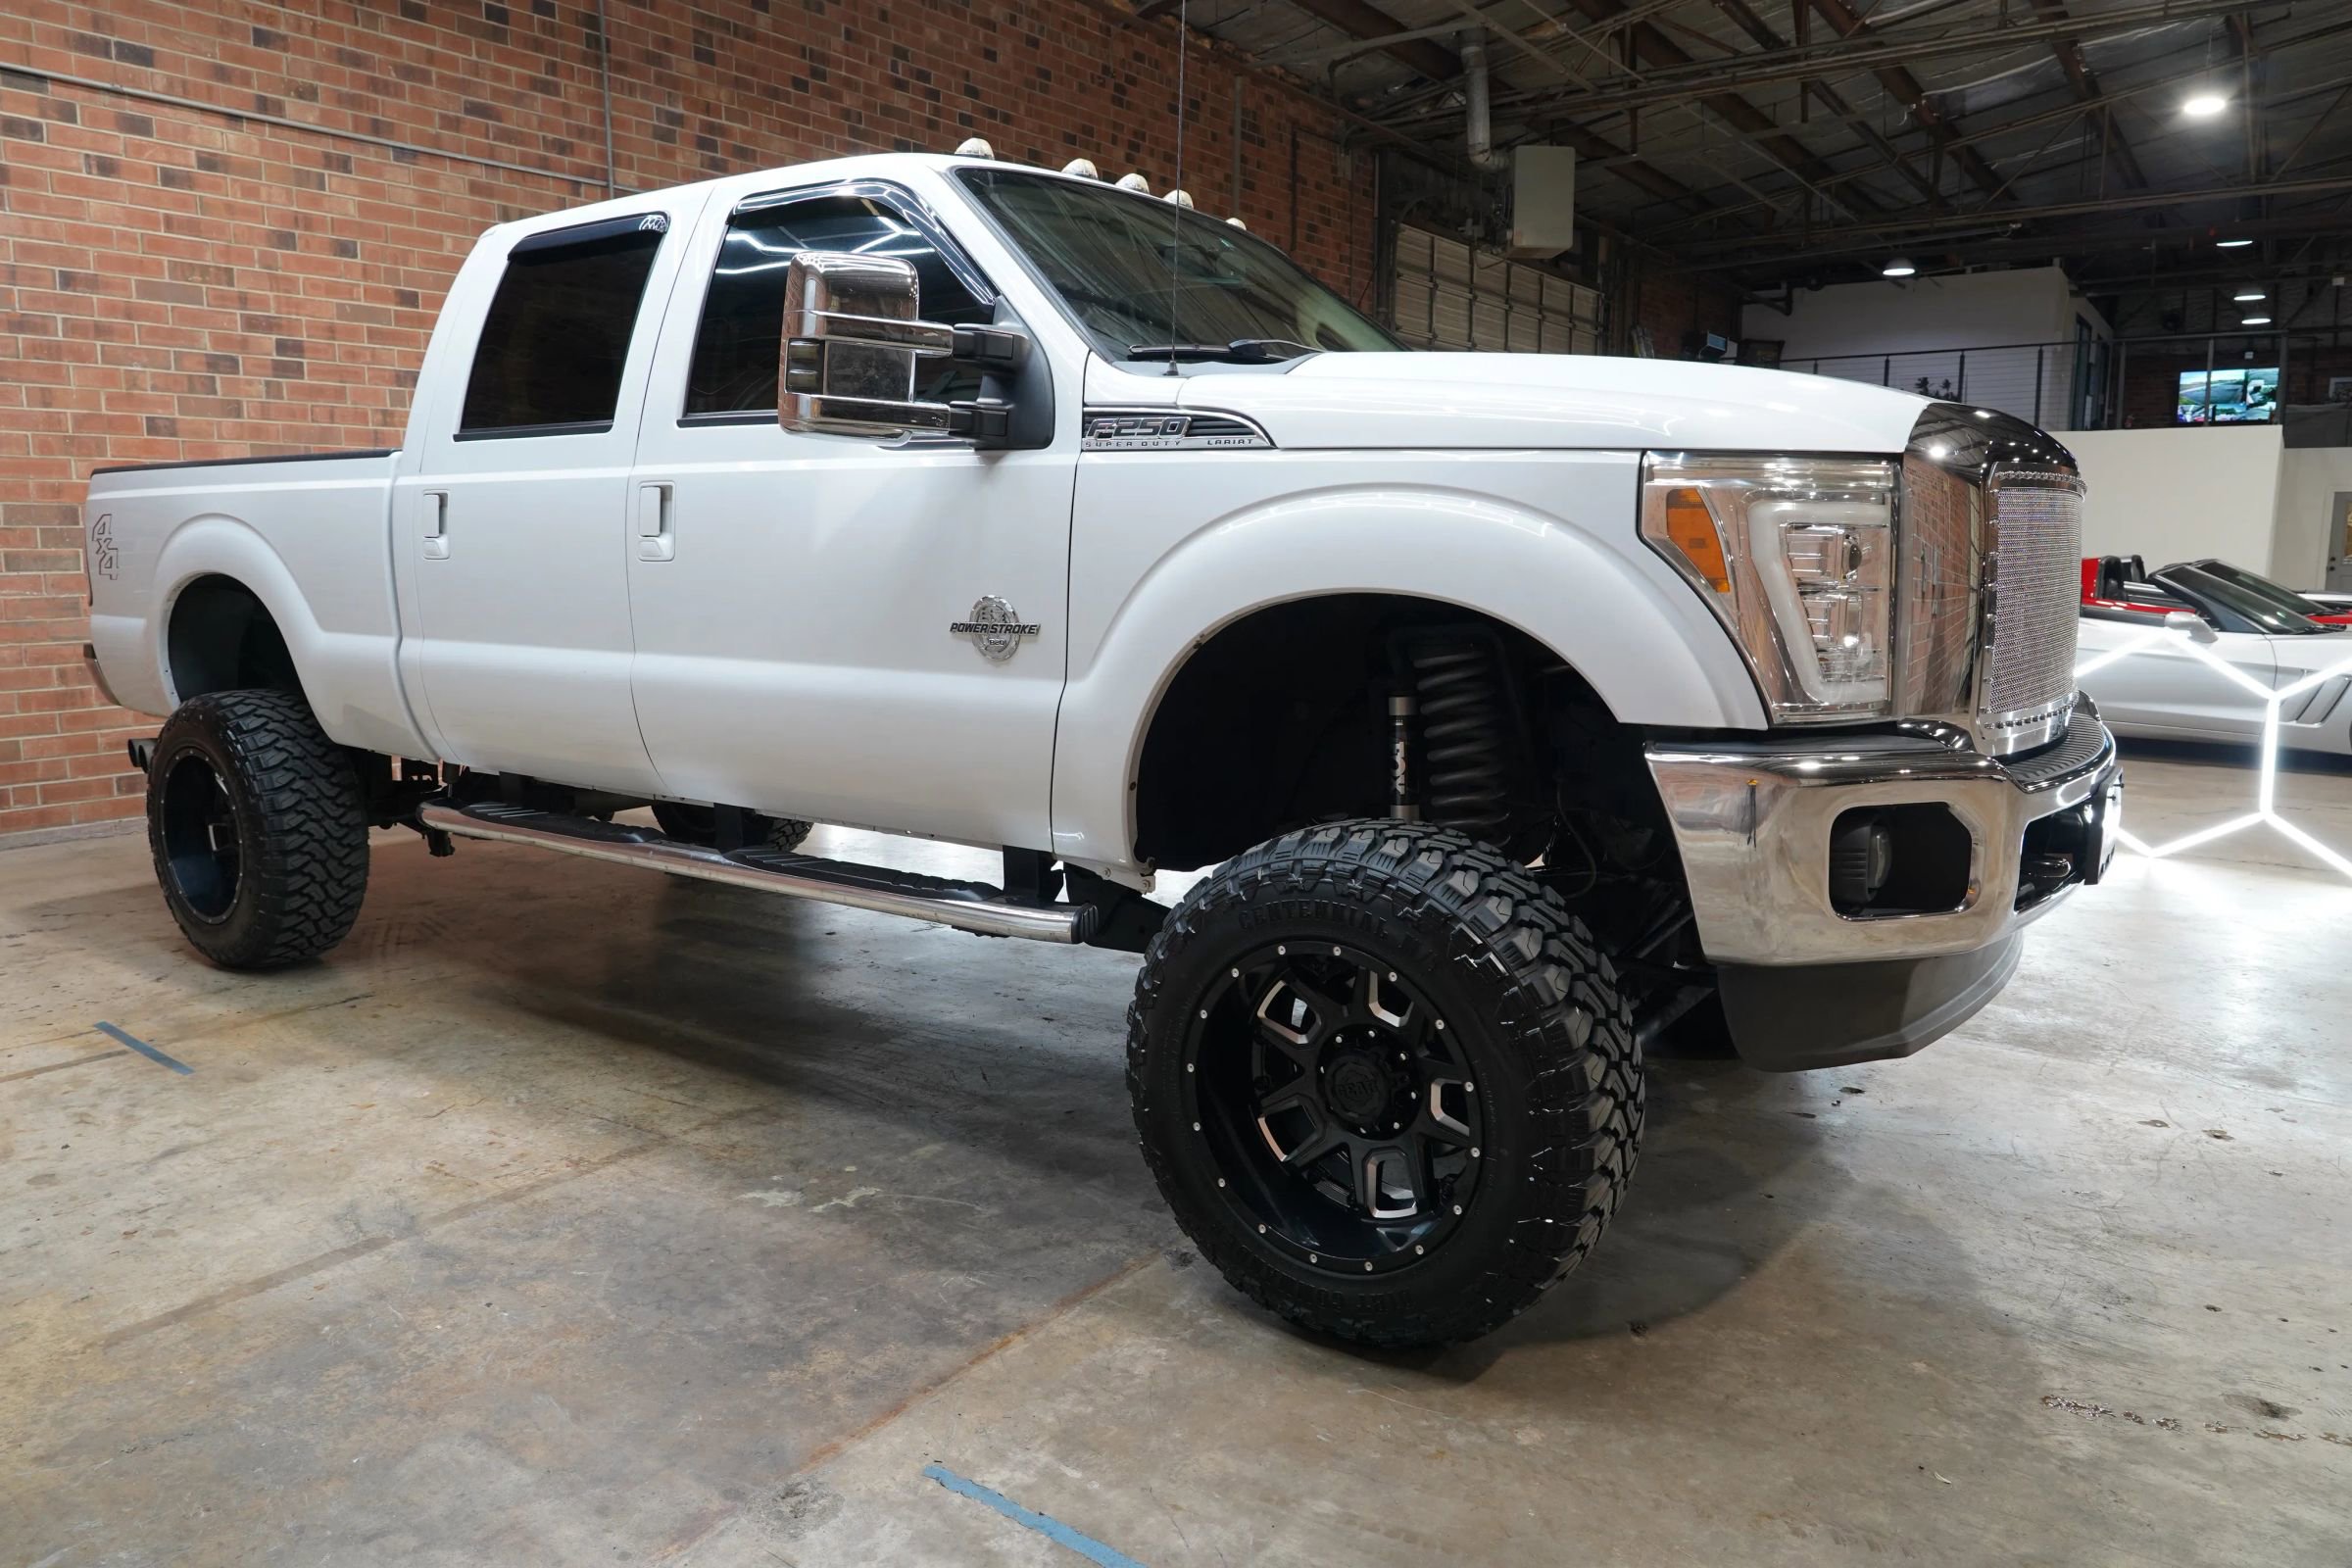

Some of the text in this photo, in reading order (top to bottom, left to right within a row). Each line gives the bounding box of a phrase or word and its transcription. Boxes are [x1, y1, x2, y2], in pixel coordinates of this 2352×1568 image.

[950, 622, 1038, 634] POWER STROKE
[1239, 898, 1389, 939] CENTENNIAL
